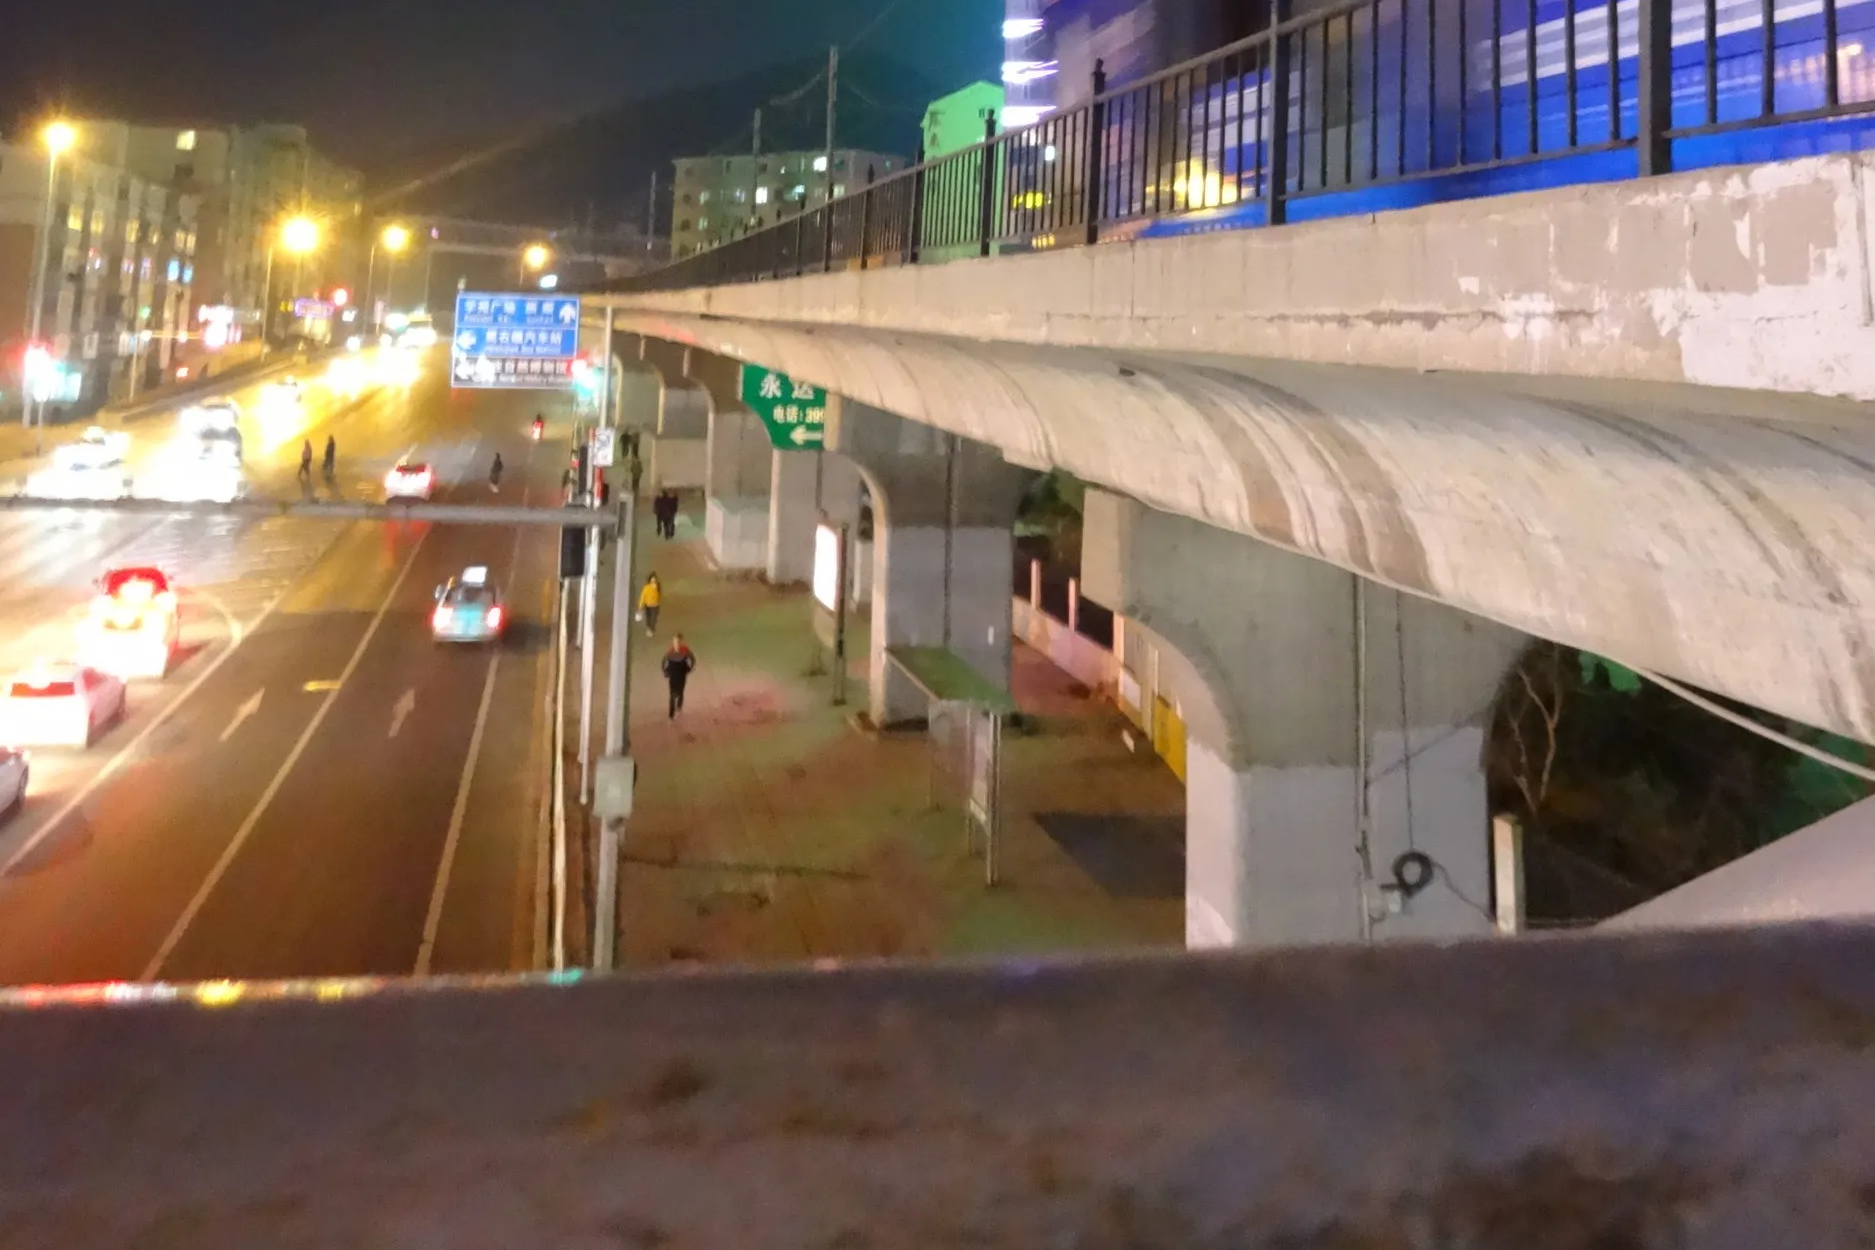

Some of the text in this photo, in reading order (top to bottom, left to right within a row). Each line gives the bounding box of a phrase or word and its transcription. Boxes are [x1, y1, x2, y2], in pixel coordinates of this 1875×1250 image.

[480, 358, 568, 374] 连自然博物馆
